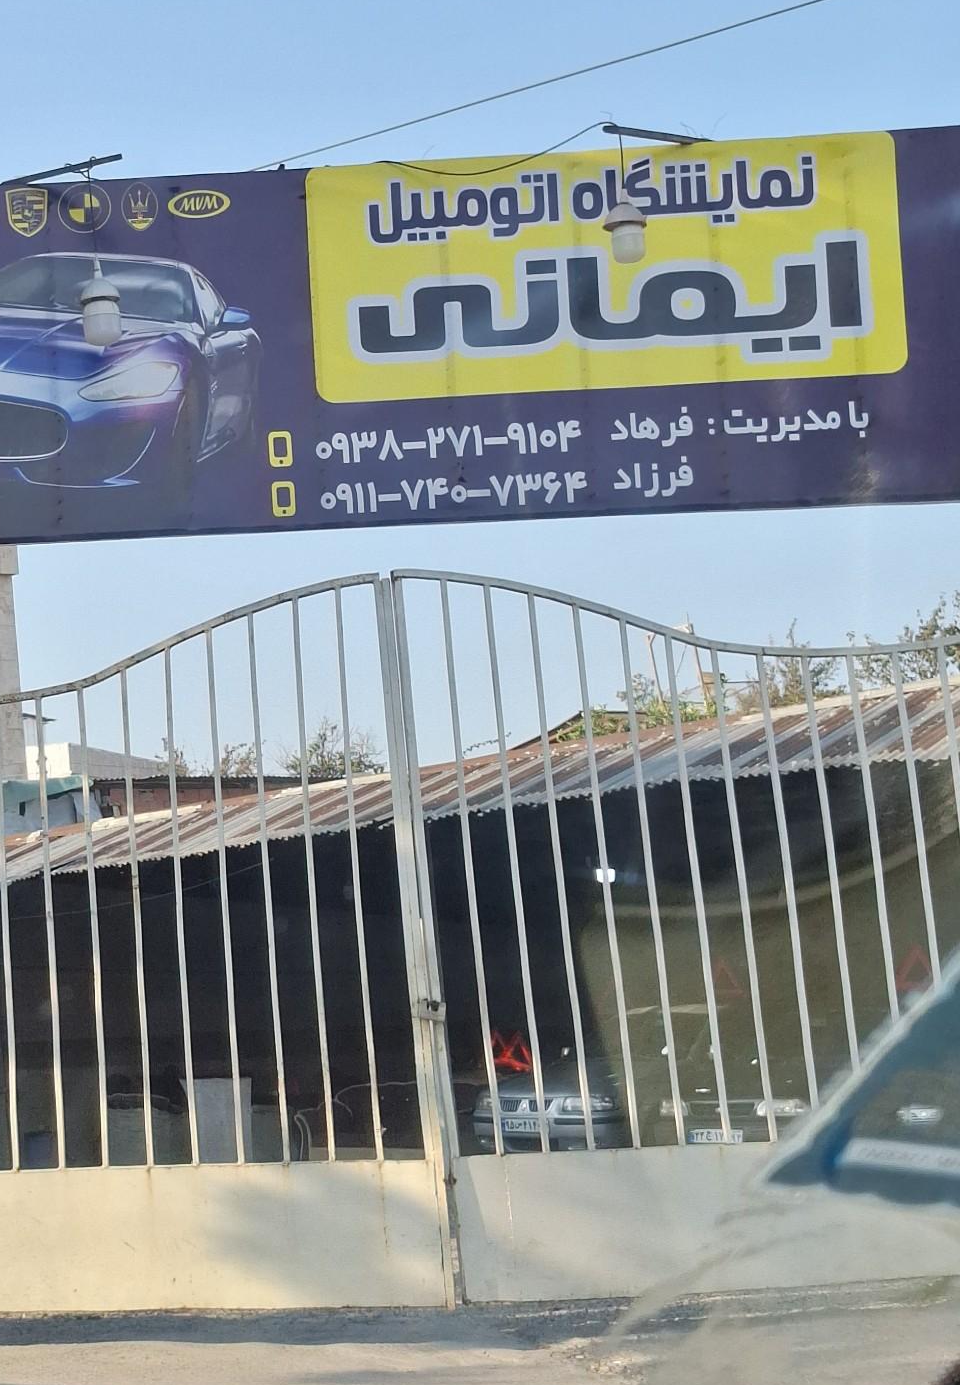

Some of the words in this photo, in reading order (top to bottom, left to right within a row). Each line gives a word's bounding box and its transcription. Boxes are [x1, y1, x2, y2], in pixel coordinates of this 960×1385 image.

[179, 194, 219, 212] MVM
[368, 172, 560, 245] اتومبیل
[572, 155, 816, 223] نمایشگاه
[358, 240, 863, 354] ایمانی
[610, 406, 694, 447] فرهاد
[847, 400, 870, 439] با
[613, 455, 694, 498] فرزاد
